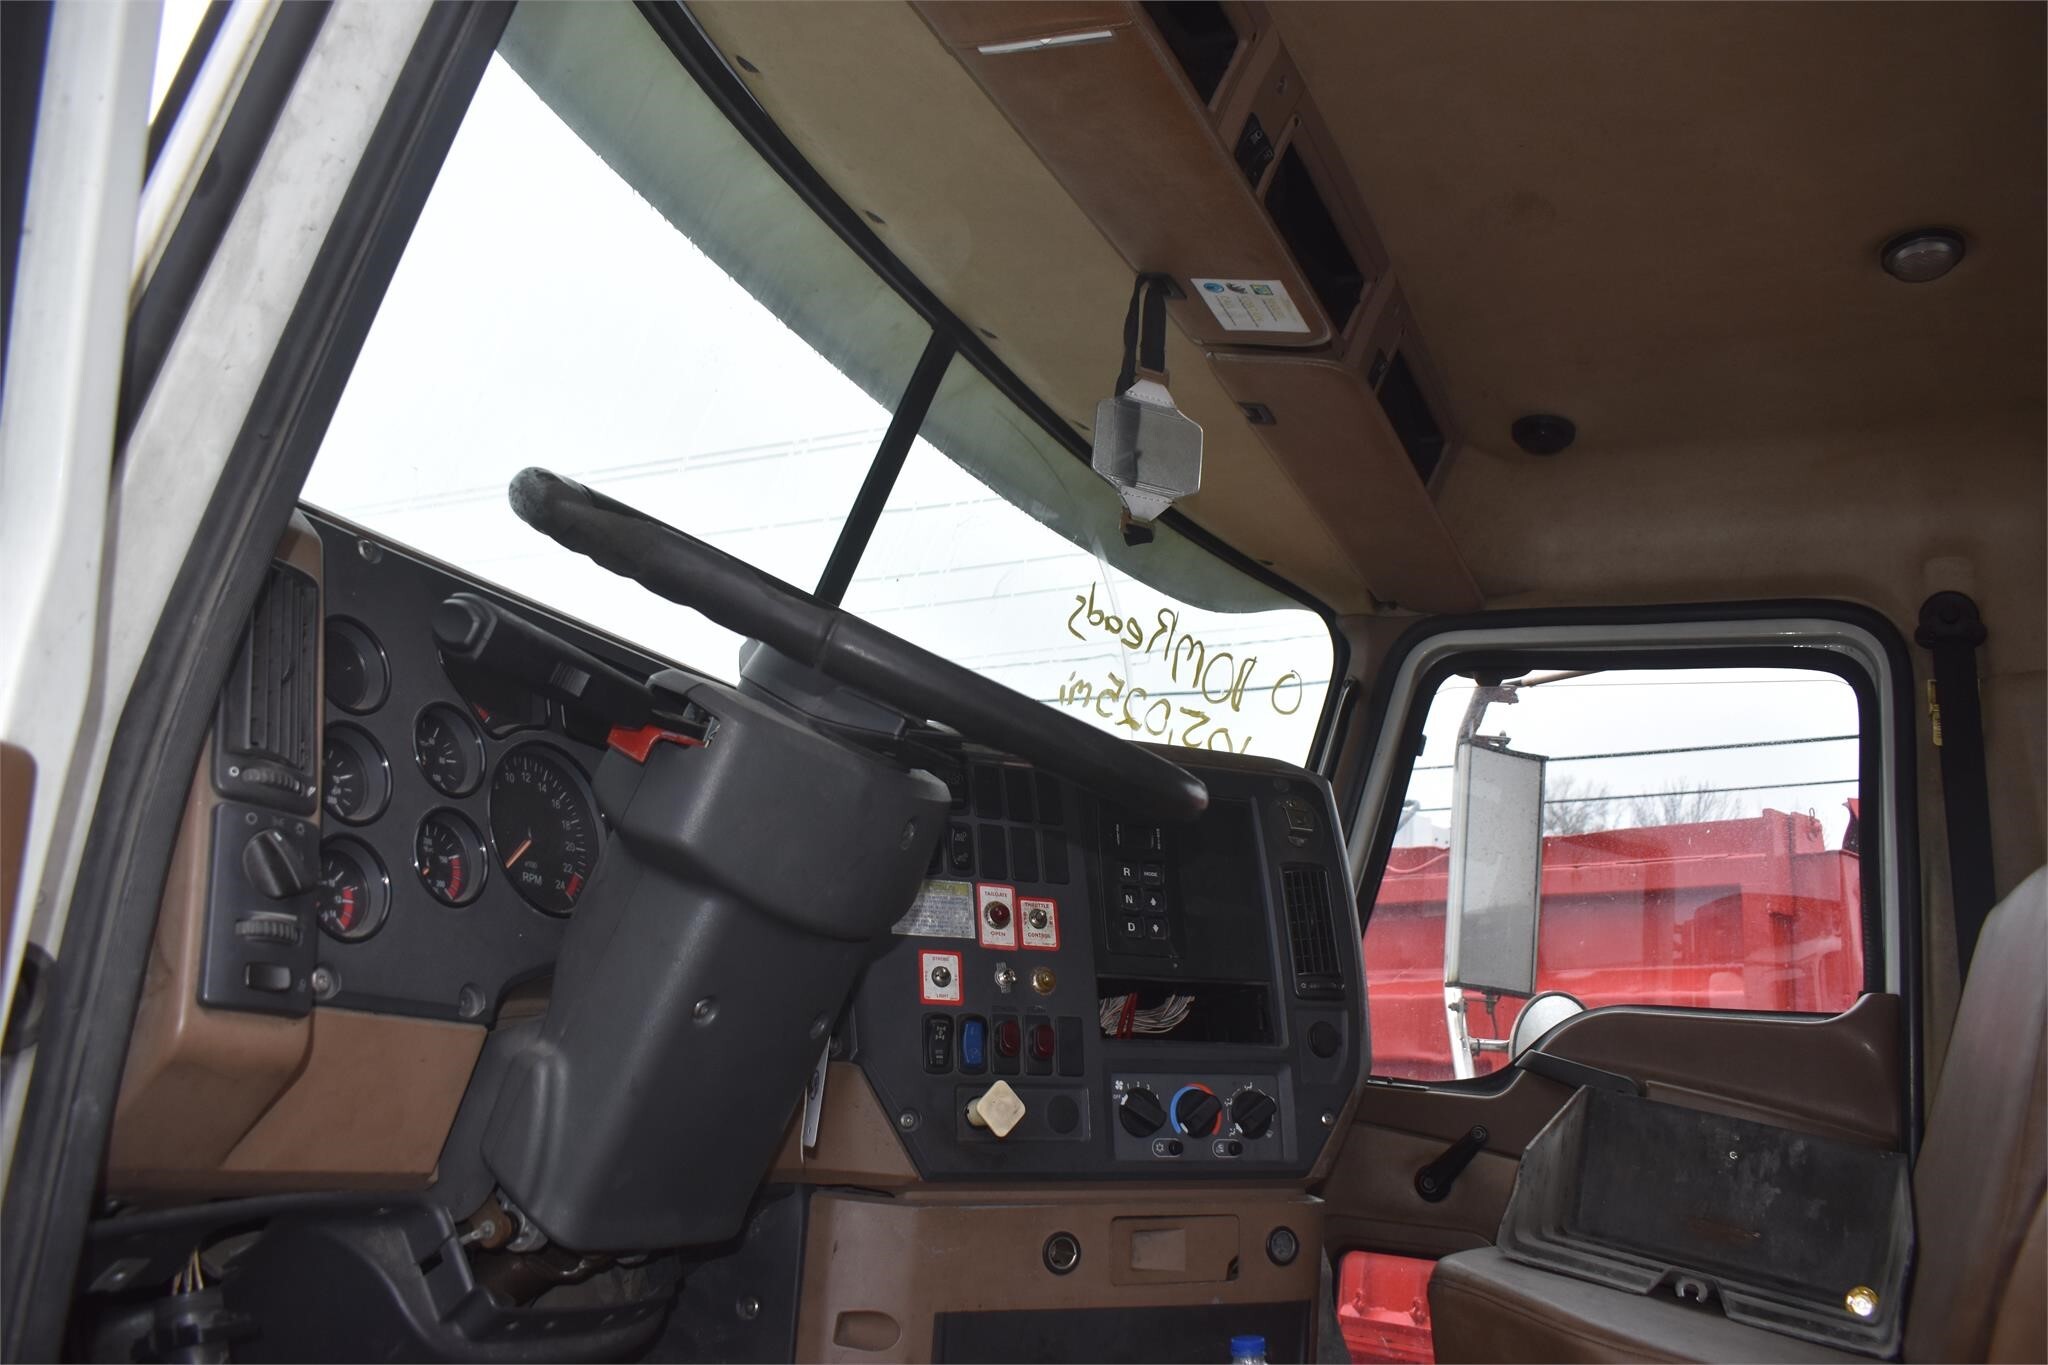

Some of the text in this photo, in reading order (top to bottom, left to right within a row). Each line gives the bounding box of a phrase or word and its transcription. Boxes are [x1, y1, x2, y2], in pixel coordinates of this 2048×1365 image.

[521, 772, 532, 784] 12
[538, 783, 547, 794] 14
[565, 841, 576, 852] 20
[562, 862, 574, 873] 22
[1123, 867, 1132, 877] R
[522, 871, 542, 887] RPM
[555, 879, 566, 890] 24
[1125, 894, 1133, 904] N
[1127, 922, 1136, 932] D
